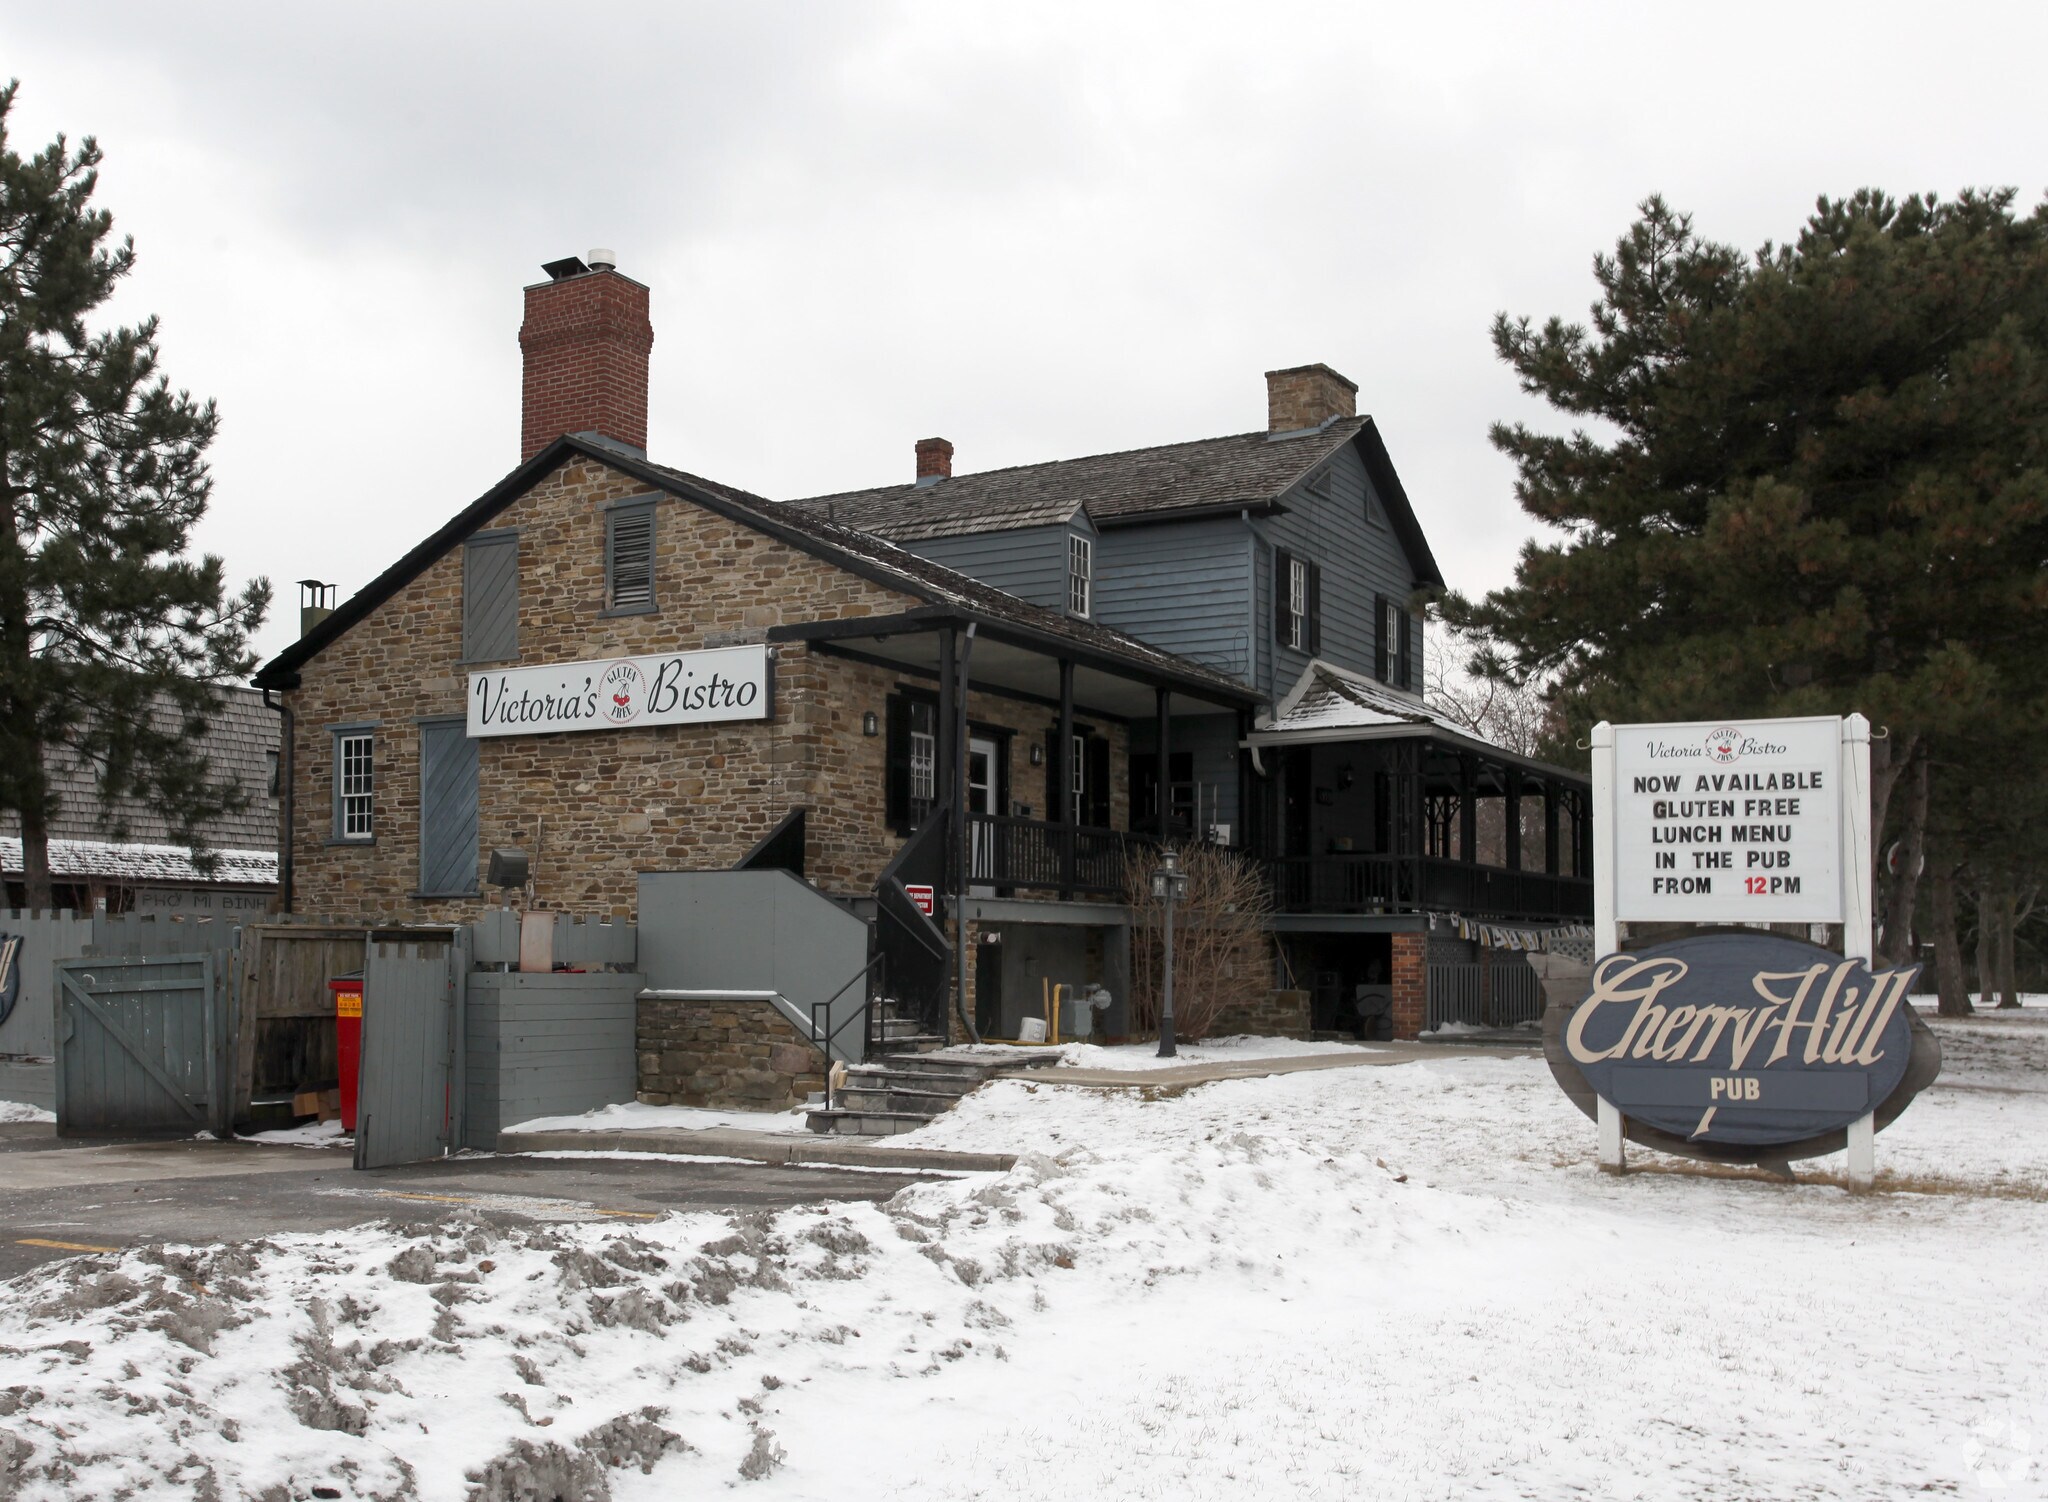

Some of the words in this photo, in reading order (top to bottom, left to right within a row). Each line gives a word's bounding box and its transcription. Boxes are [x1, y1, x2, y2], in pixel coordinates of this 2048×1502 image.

[606, 666, 639, 684] GLUTEN
[476, 676, 598, 725] Victoria's
[647, 658, 757, 714] Bistro
[610, 705, 634, 719] FREE
[1712, 729, 1738, 741] GLUTEN
[1646, 738, 1712, 759] Victoria's
[1738, 737, 1787, 756] Bistro
[1716, 753, 1735, 762] FREE
[1633, 775, 1681, 794] NOW
[1694, 771, 1823, 793] AVAILABLE
[1653, 800, 1735, 819] GLUTEN
[1744, 798, 1800, 817] FREE
[1652, 825, 1722, 844] LUNCH
[1731, 824, 1792, 843] MENU
[1655, 852, 1676, 869] IN
[1692, 851, 1733, 869] THE
[1746, 850, 1791, 869] PUB
[1652, 877, 1712, 894] FROM
[1744, 876, 1801, 894] 12PM
[1566, 955, 1780, 1138] Cherry
[1752, 959, 1919, 1068] Hill
[1710, 1077, 1761, 1101] PUB
